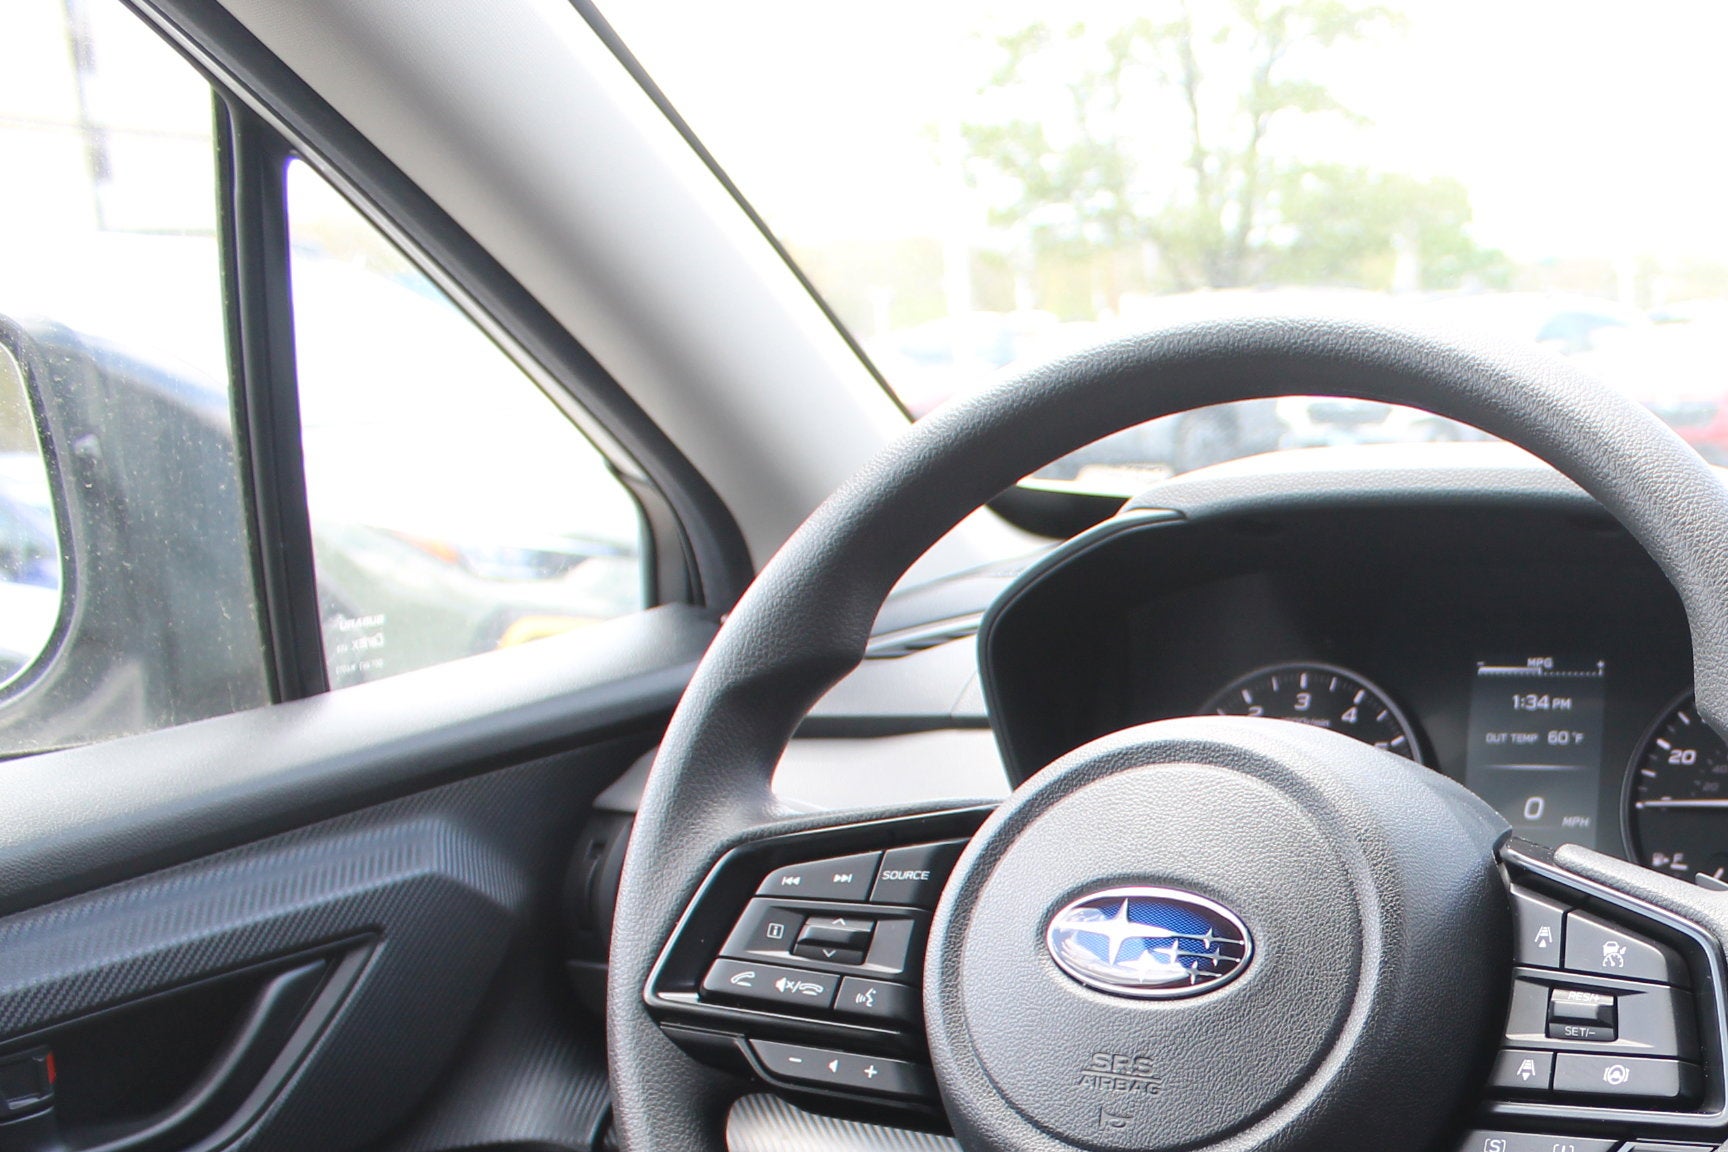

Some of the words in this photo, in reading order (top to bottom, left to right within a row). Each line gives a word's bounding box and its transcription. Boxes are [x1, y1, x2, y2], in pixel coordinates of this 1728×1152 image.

[1527, 657, 1553, 669] MPG
[1294, 692, 1311, 711] 3
[1512, 694, 1550, 711] 1:34
[1552, 697, 1572, 710] PM
[1341, 706, 1358, 723] 4
[1485, 732, 1507, 744] OUT
[1510, 732, 1539, 744] TEMP
[1547, 730, 1570, 745] 60
[1668, 749, 1697, 765] 20
[1524, 796, 1544, 820] 0
[1561, 816, 1590, 828] MPH
[882, 869, 930, 881] SOURCE
[1091, 1052, 1154, 1076] SRS
[1078, 1074, 1162, 1096] AIRBAG
